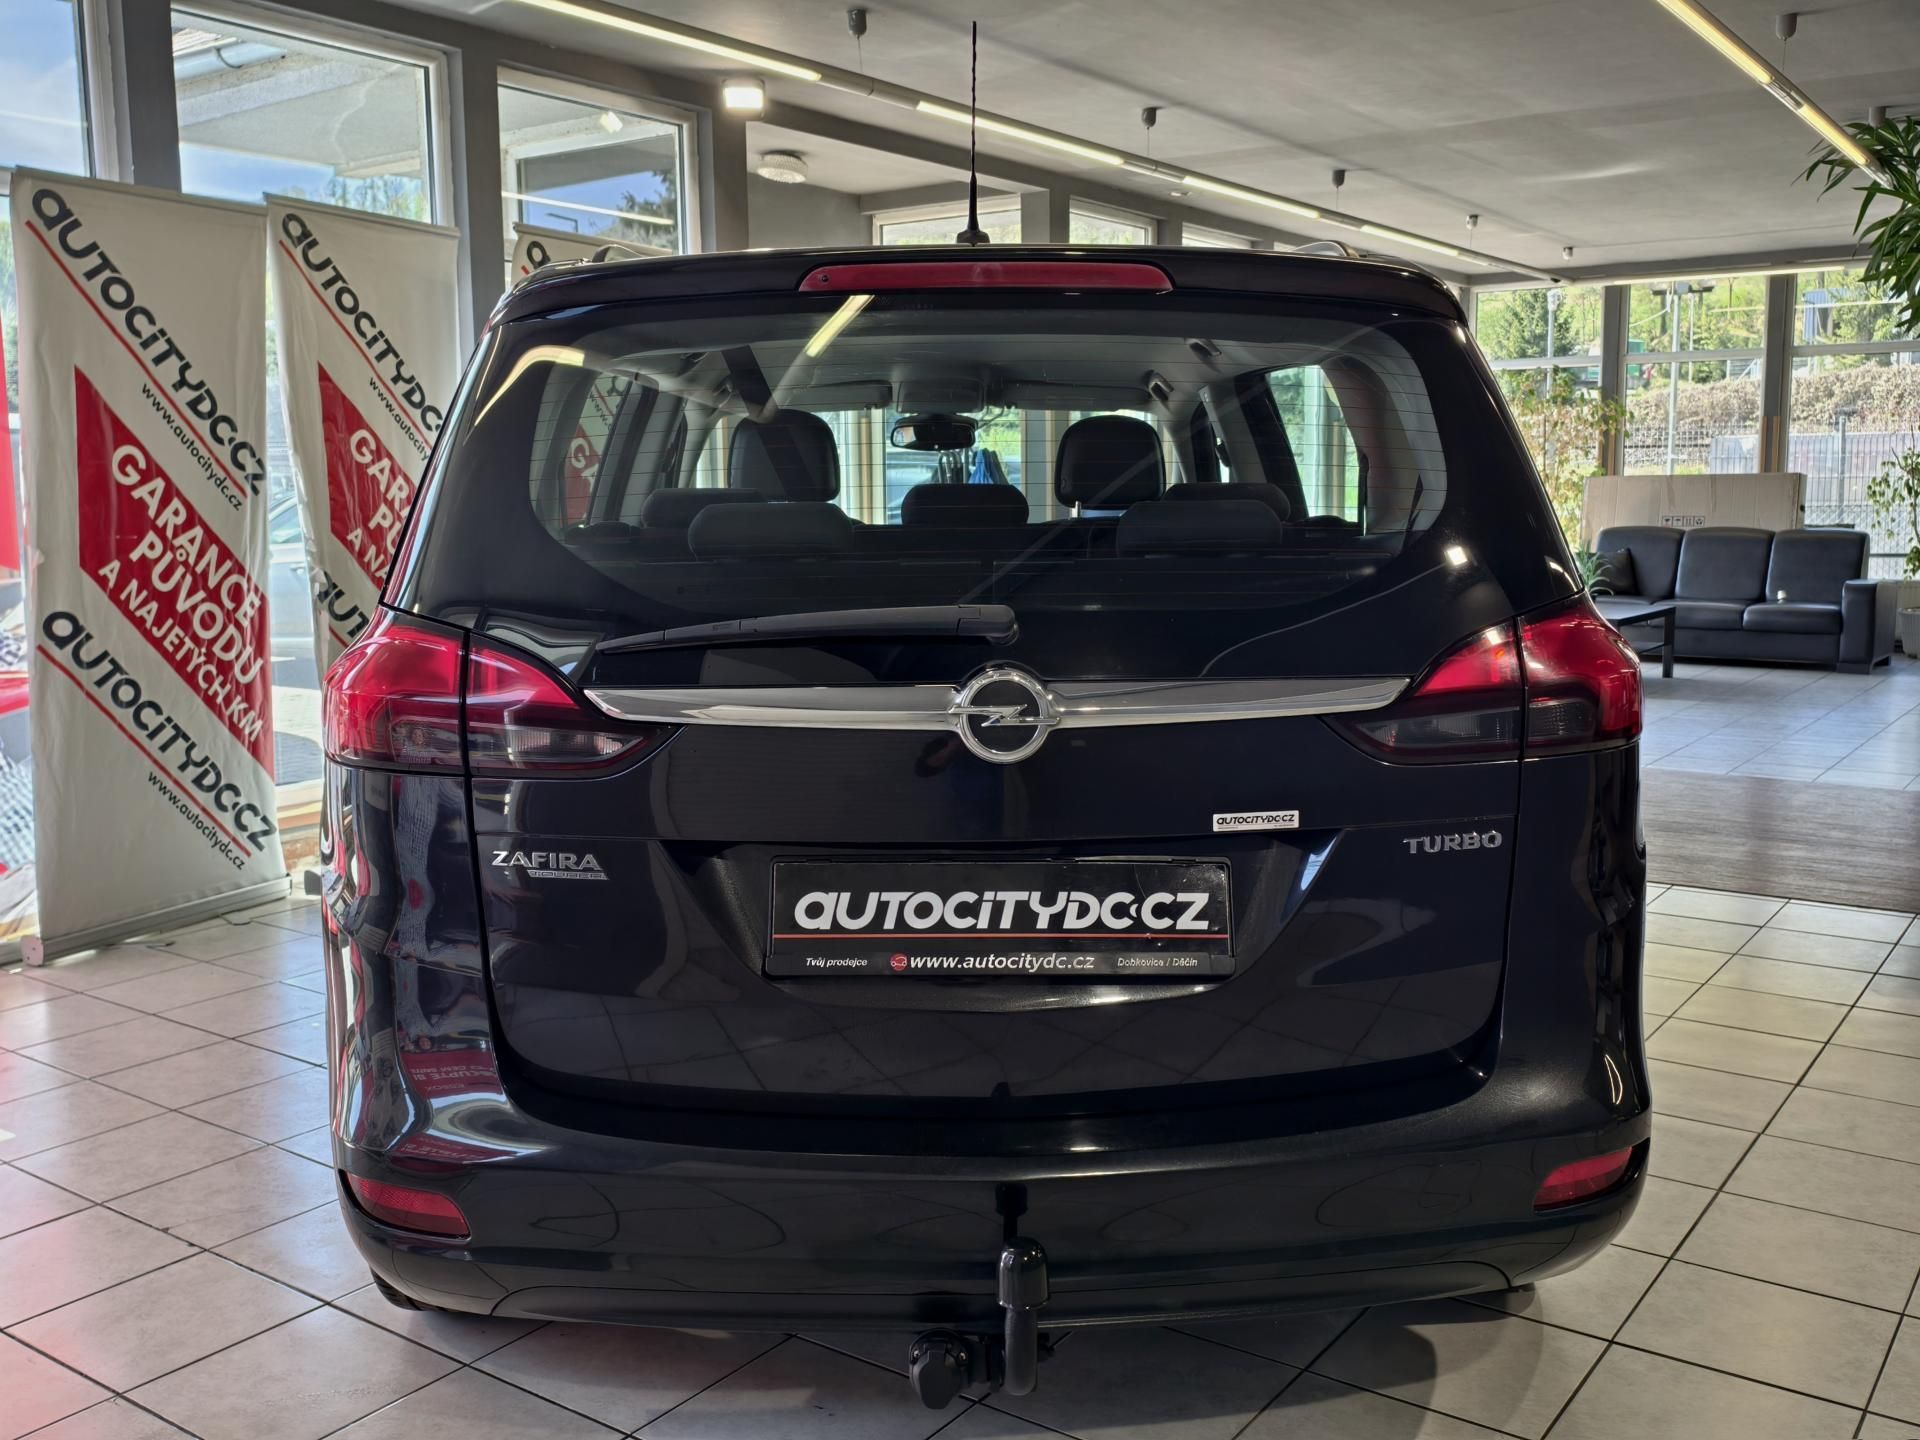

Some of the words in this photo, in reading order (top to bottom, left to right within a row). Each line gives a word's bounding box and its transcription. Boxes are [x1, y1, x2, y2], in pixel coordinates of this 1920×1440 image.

[142, 383, 243, 511] www.autocitydc.cz
[112, 444, 262, 628] GARANCE
[347, 527, 363, 551] A
[129, 530, 264, 684] PŮVODU
[98, 559, 121, 589] A
[120, 578, 232, 704] NAJETÝCH
[226, 695, 264, 742] KM
[148, 771, 245, 870] www.autocitydc.cz
[1403, 830, 1503, 854] TURBO
[491, 850, 603, 871] ZAFIRA
[826, 957, 868, 968] prodejce
[910, 951, 1095, 973] www.autocitydc.cz
[1117, 957, 1164, 967] Dobkovice
